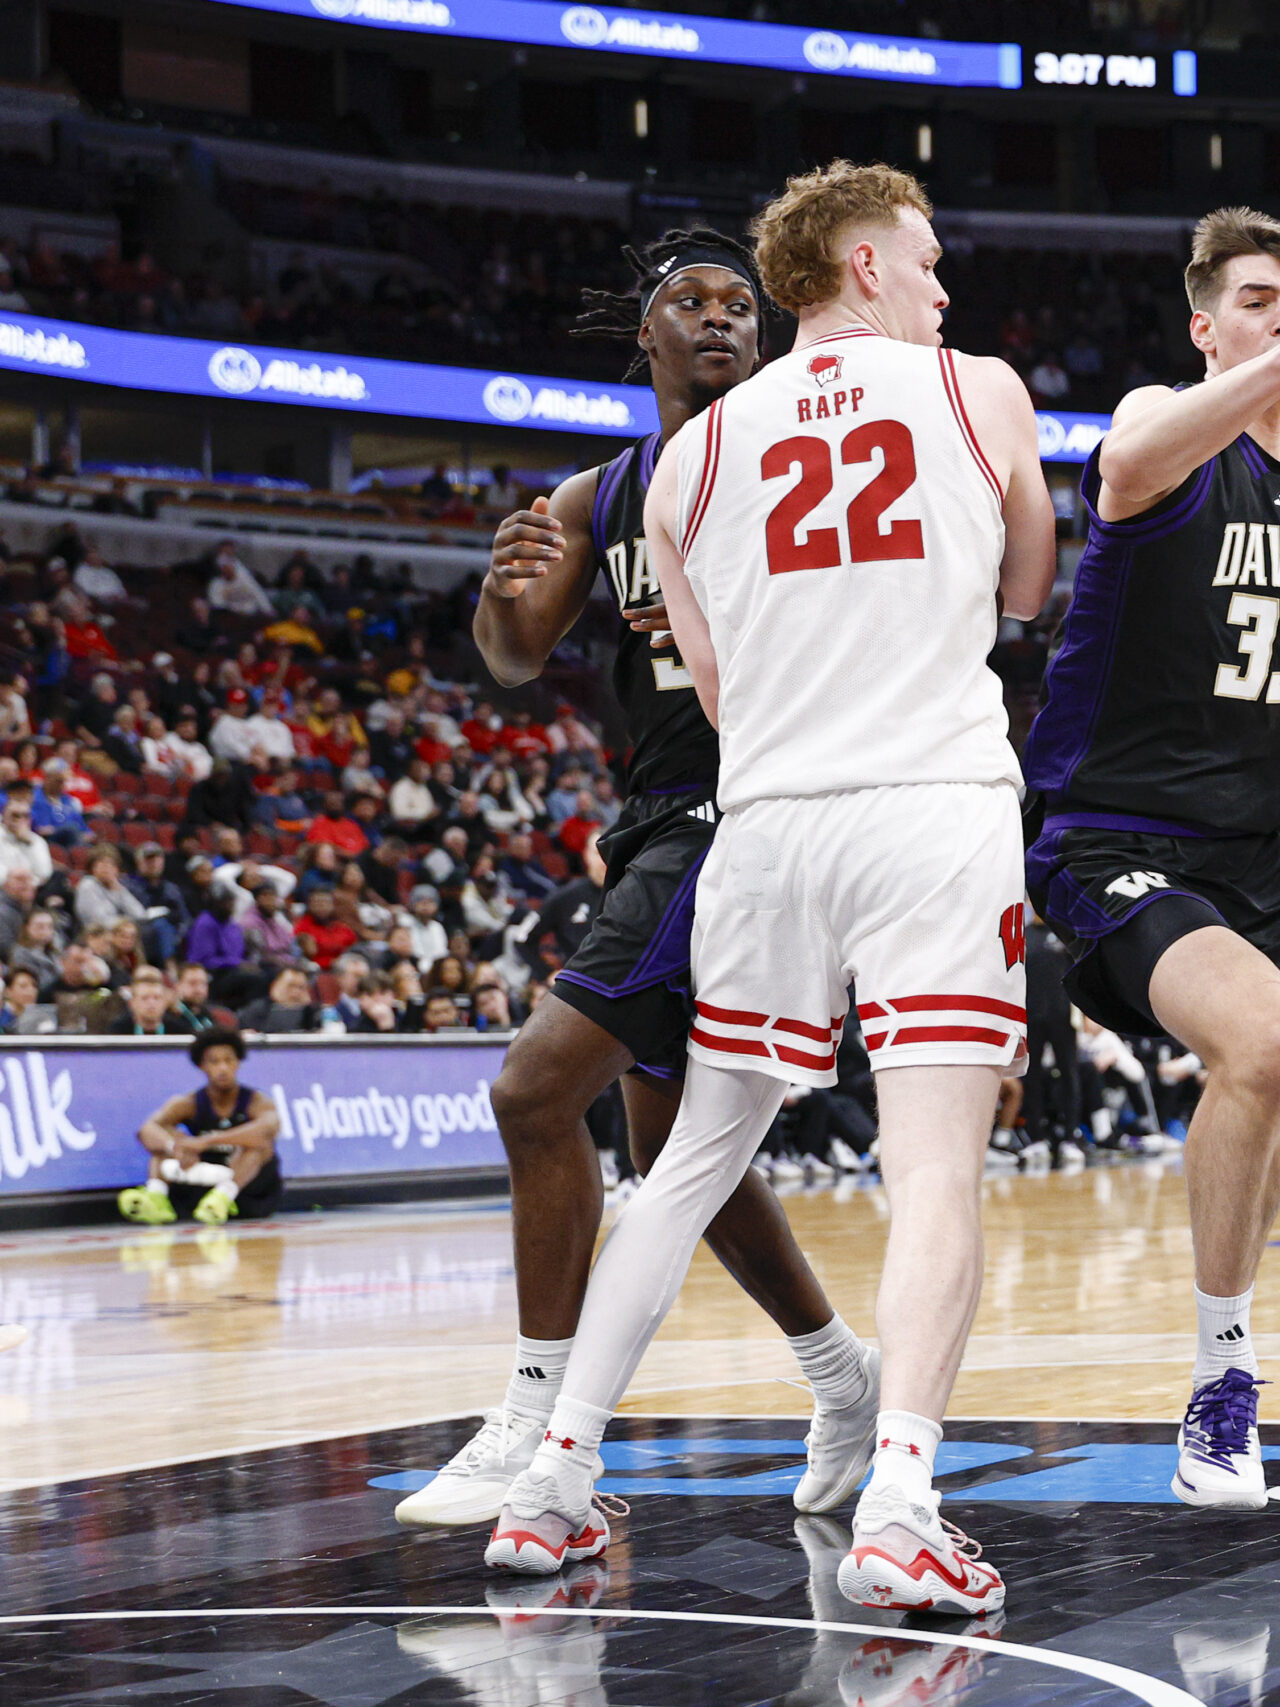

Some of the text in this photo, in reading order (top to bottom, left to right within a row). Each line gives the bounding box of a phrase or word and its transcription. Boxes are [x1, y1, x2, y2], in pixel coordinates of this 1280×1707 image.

[605, 17, 699, 52] Allstate
[847, 42, 936, 75] Allstate
[1034, 52, 1156, 88] 3:07 PM
[0, 323, 85, 368] llstate
[259, 359, 366, 400] Allstate
[530, 388, 629, 427] Allstate
[797, 387, 865, 423] RAPP
[760, 419, 925, 576] 22
[295, 1082, 410, 1153] planty
